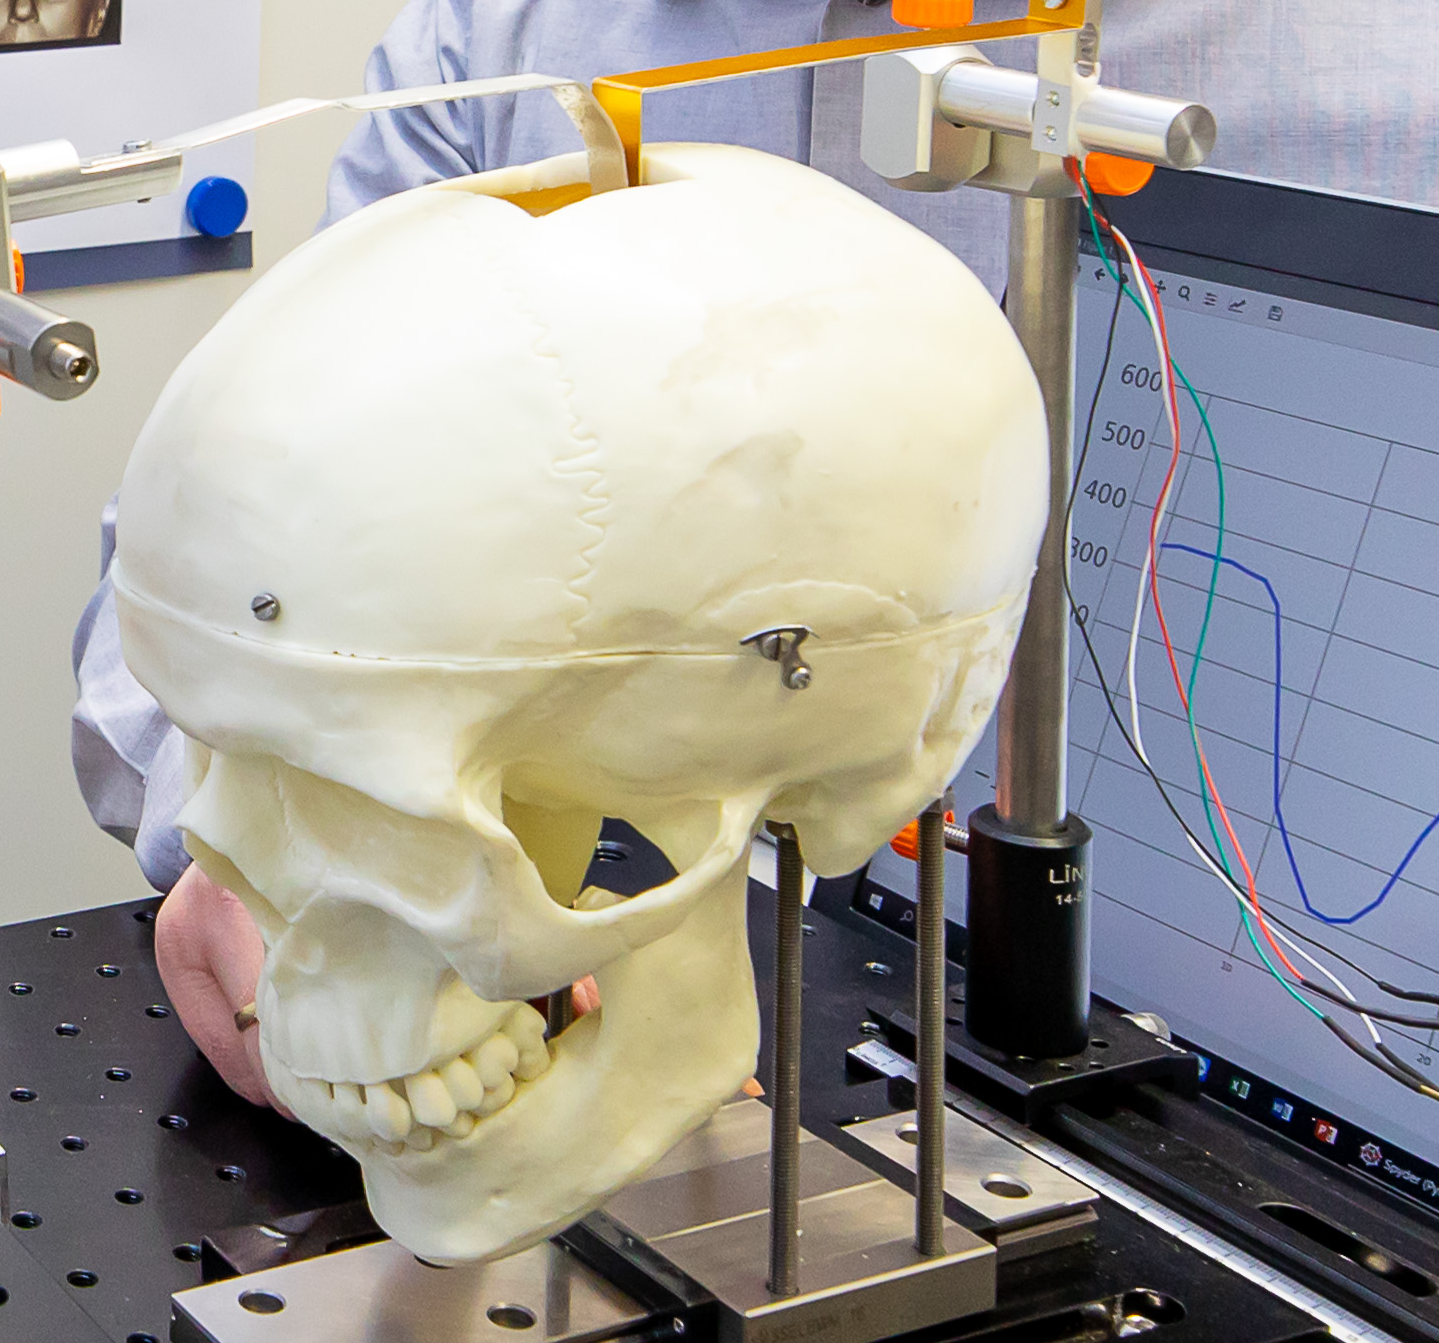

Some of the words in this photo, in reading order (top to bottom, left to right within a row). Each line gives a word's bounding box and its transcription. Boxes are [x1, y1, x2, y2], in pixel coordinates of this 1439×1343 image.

[1120, 362, 1164, 396] 600
[1100, 419, 1147, 453] 500
[1083, 478, 1128, 511] 400
[1383, 1157, 1422, 1187] Spyder
